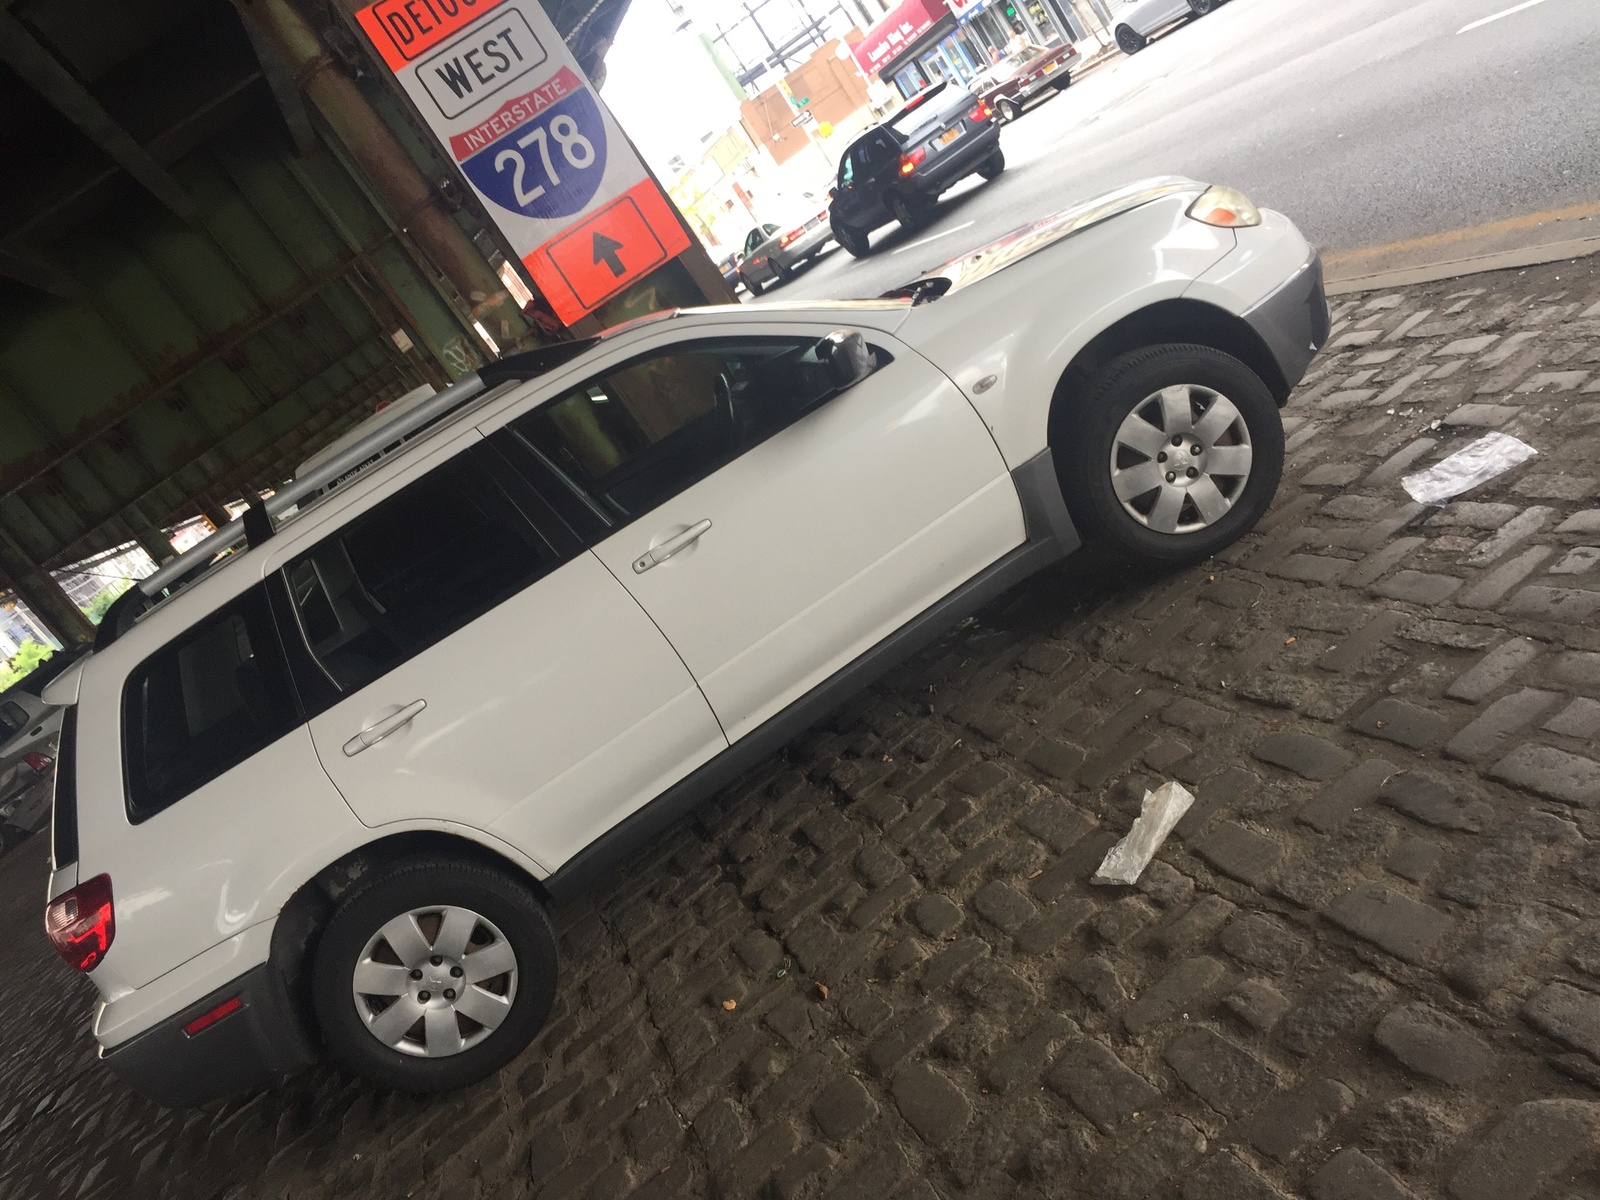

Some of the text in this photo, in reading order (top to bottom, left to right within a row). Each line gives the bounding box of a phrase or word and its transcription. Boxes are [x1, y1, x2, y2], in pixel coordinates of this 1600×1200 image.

[386, 0, 477, 45] DETO
[434, 27, 525, 100] WEST
[463, 78, 567, 151] INTERSTATE
[494, 114, 596, 208] 278
